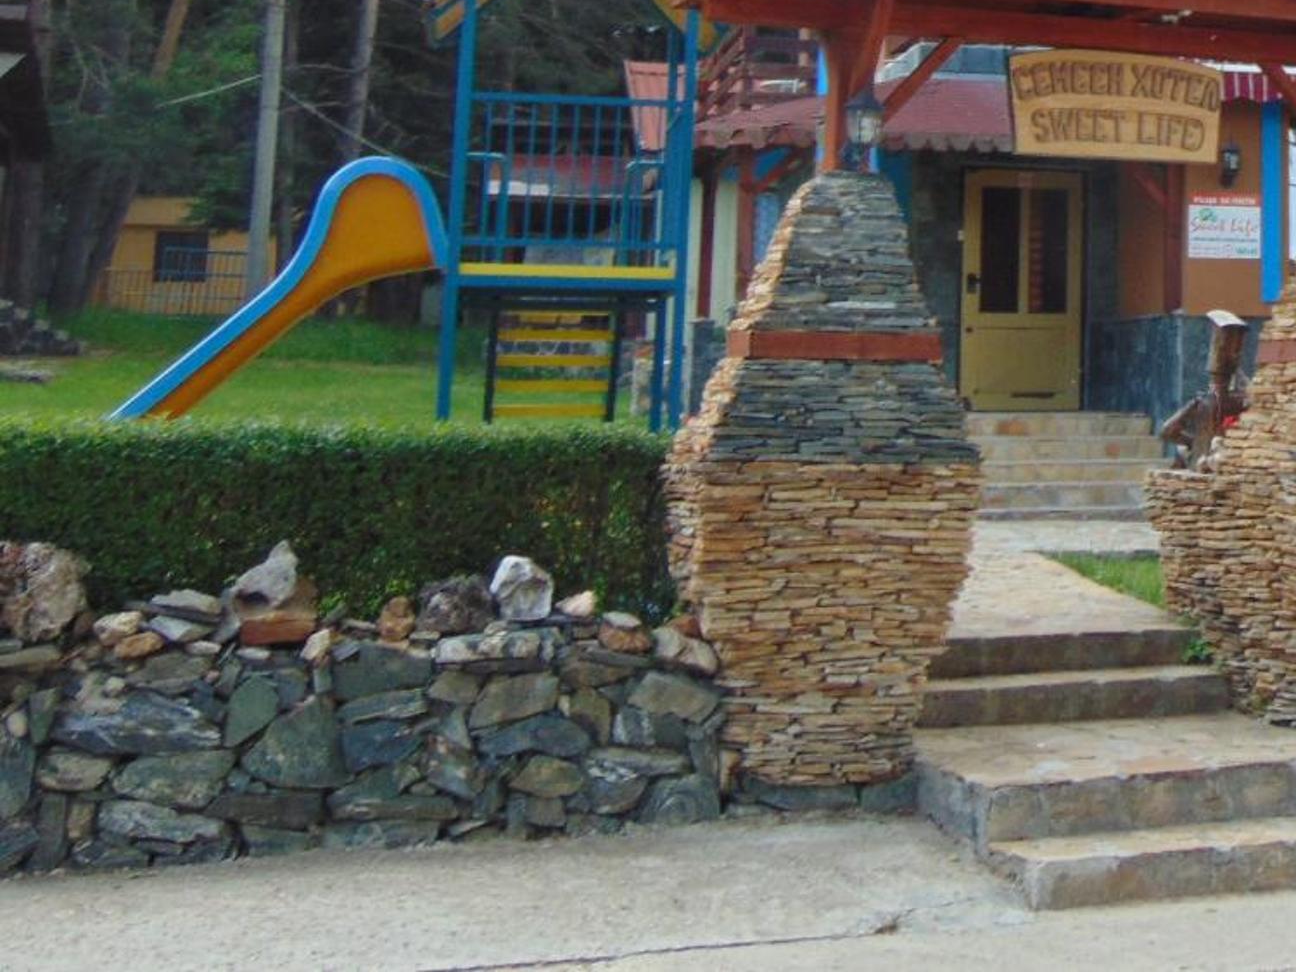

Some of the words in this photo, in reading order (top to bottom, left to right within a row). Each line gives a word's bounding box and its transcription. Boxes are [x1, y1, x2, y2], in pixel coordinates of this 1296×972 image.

[1130, 64, 1220, 113] ХОТЕЛ
[1030, 107, 1125, 143] SWEET
[1137, 111, 1205, 152] LIFE
